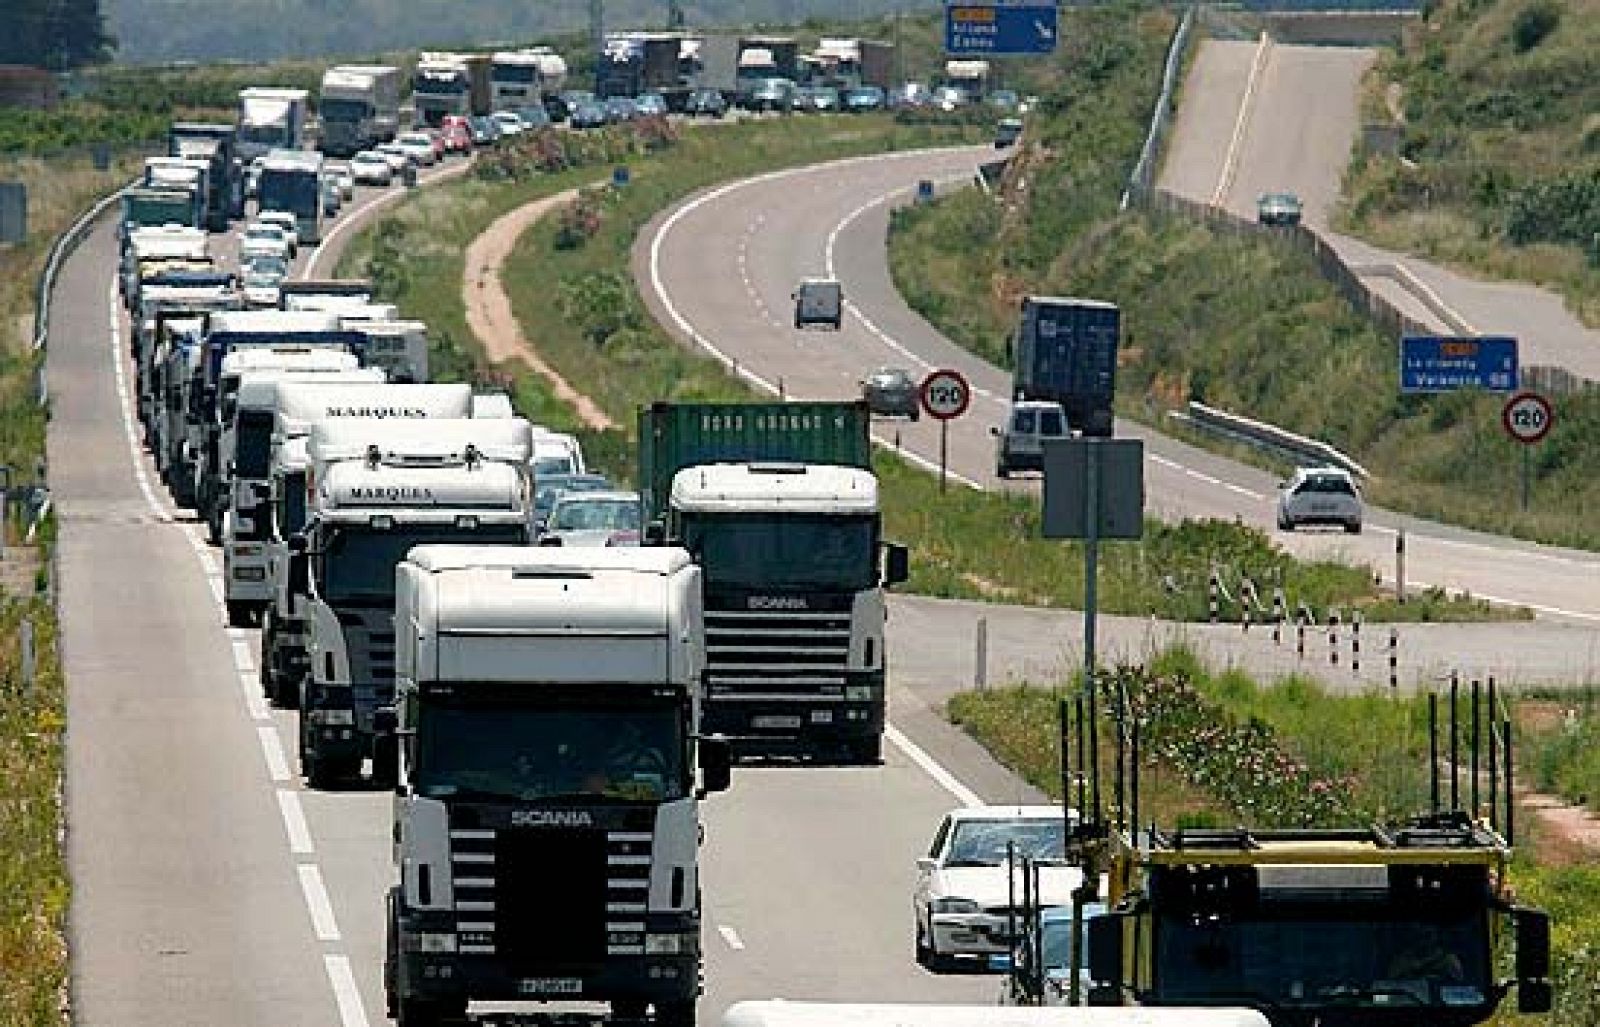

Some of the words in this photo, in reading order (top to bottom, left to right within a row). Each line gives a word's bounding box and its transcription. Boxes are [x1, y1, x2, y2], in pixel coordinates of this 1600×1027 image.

[931, 386, 961, 405] 120
[325, 406, 428, 419] MARQUES
[1514, 408, 1545, 428] 120
[350, 487, 433, 500] MARQUES
[747, 596, 810, 609] SCANIA
[511, 811, 592, 826] SCANIA
